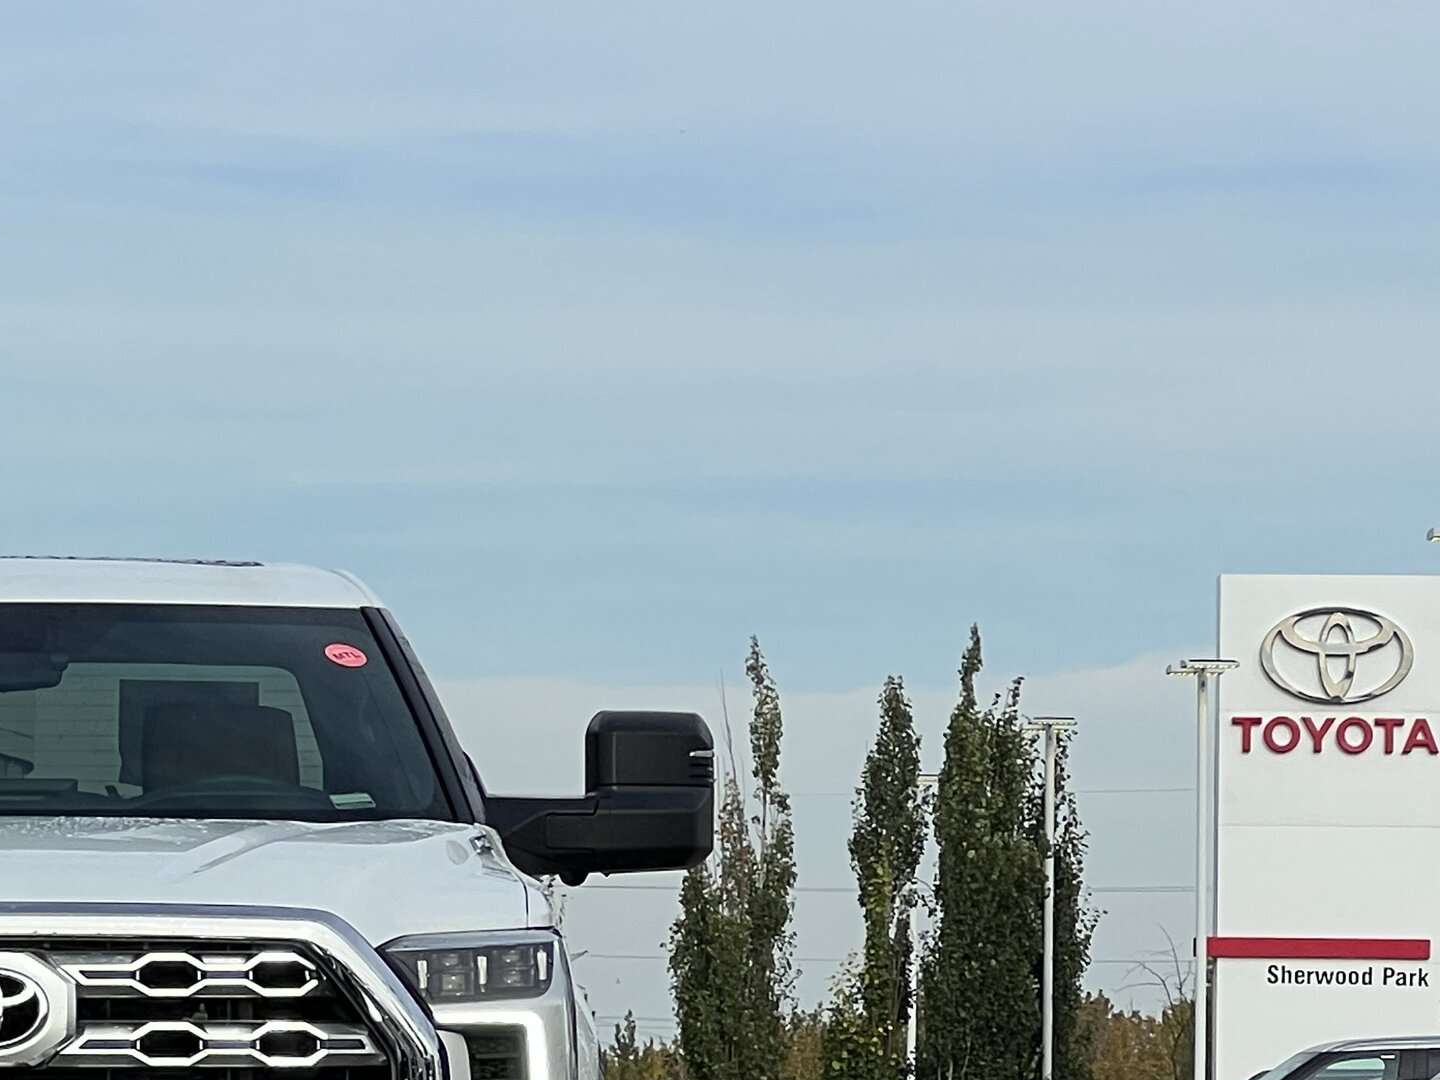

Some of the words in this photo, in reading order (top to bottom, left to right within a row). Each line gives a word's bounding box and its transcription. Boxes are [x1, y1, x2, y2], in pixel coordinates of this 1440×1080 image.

[1231, 716, 1439, 755] TOYOTA
[1267, 965, 1373, 986] Sherwood
[1383, 967, 1430, 987] Park
